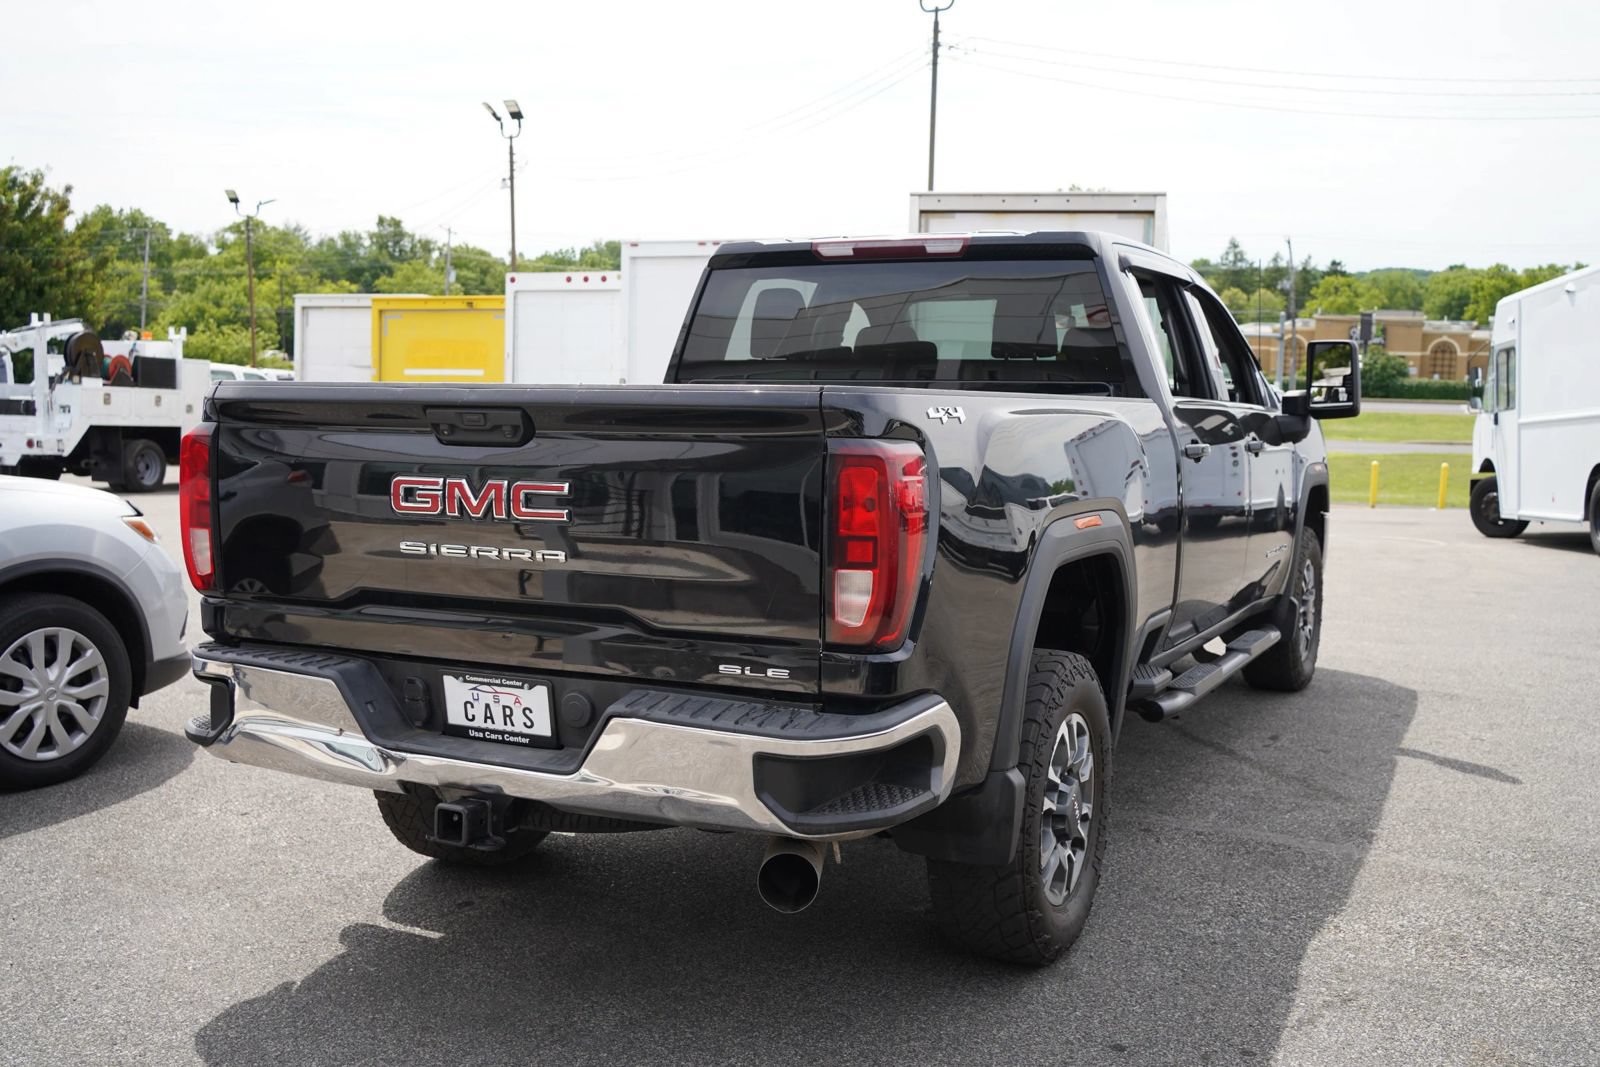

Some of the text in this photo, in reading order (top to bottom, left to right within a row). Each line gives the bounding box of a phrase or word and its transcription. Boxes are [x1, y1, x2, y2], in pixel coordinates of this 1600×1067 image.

[390, 475, 570, 522] GMC
[399, 540, 567, 563] SIERRA
[465, 674, 523, 687] Commercial Center
[718, 664, 791, 679] SLE
[463, 700, 535, 729] CARS
[468, 729, 530, 744] Usa Cars Center
